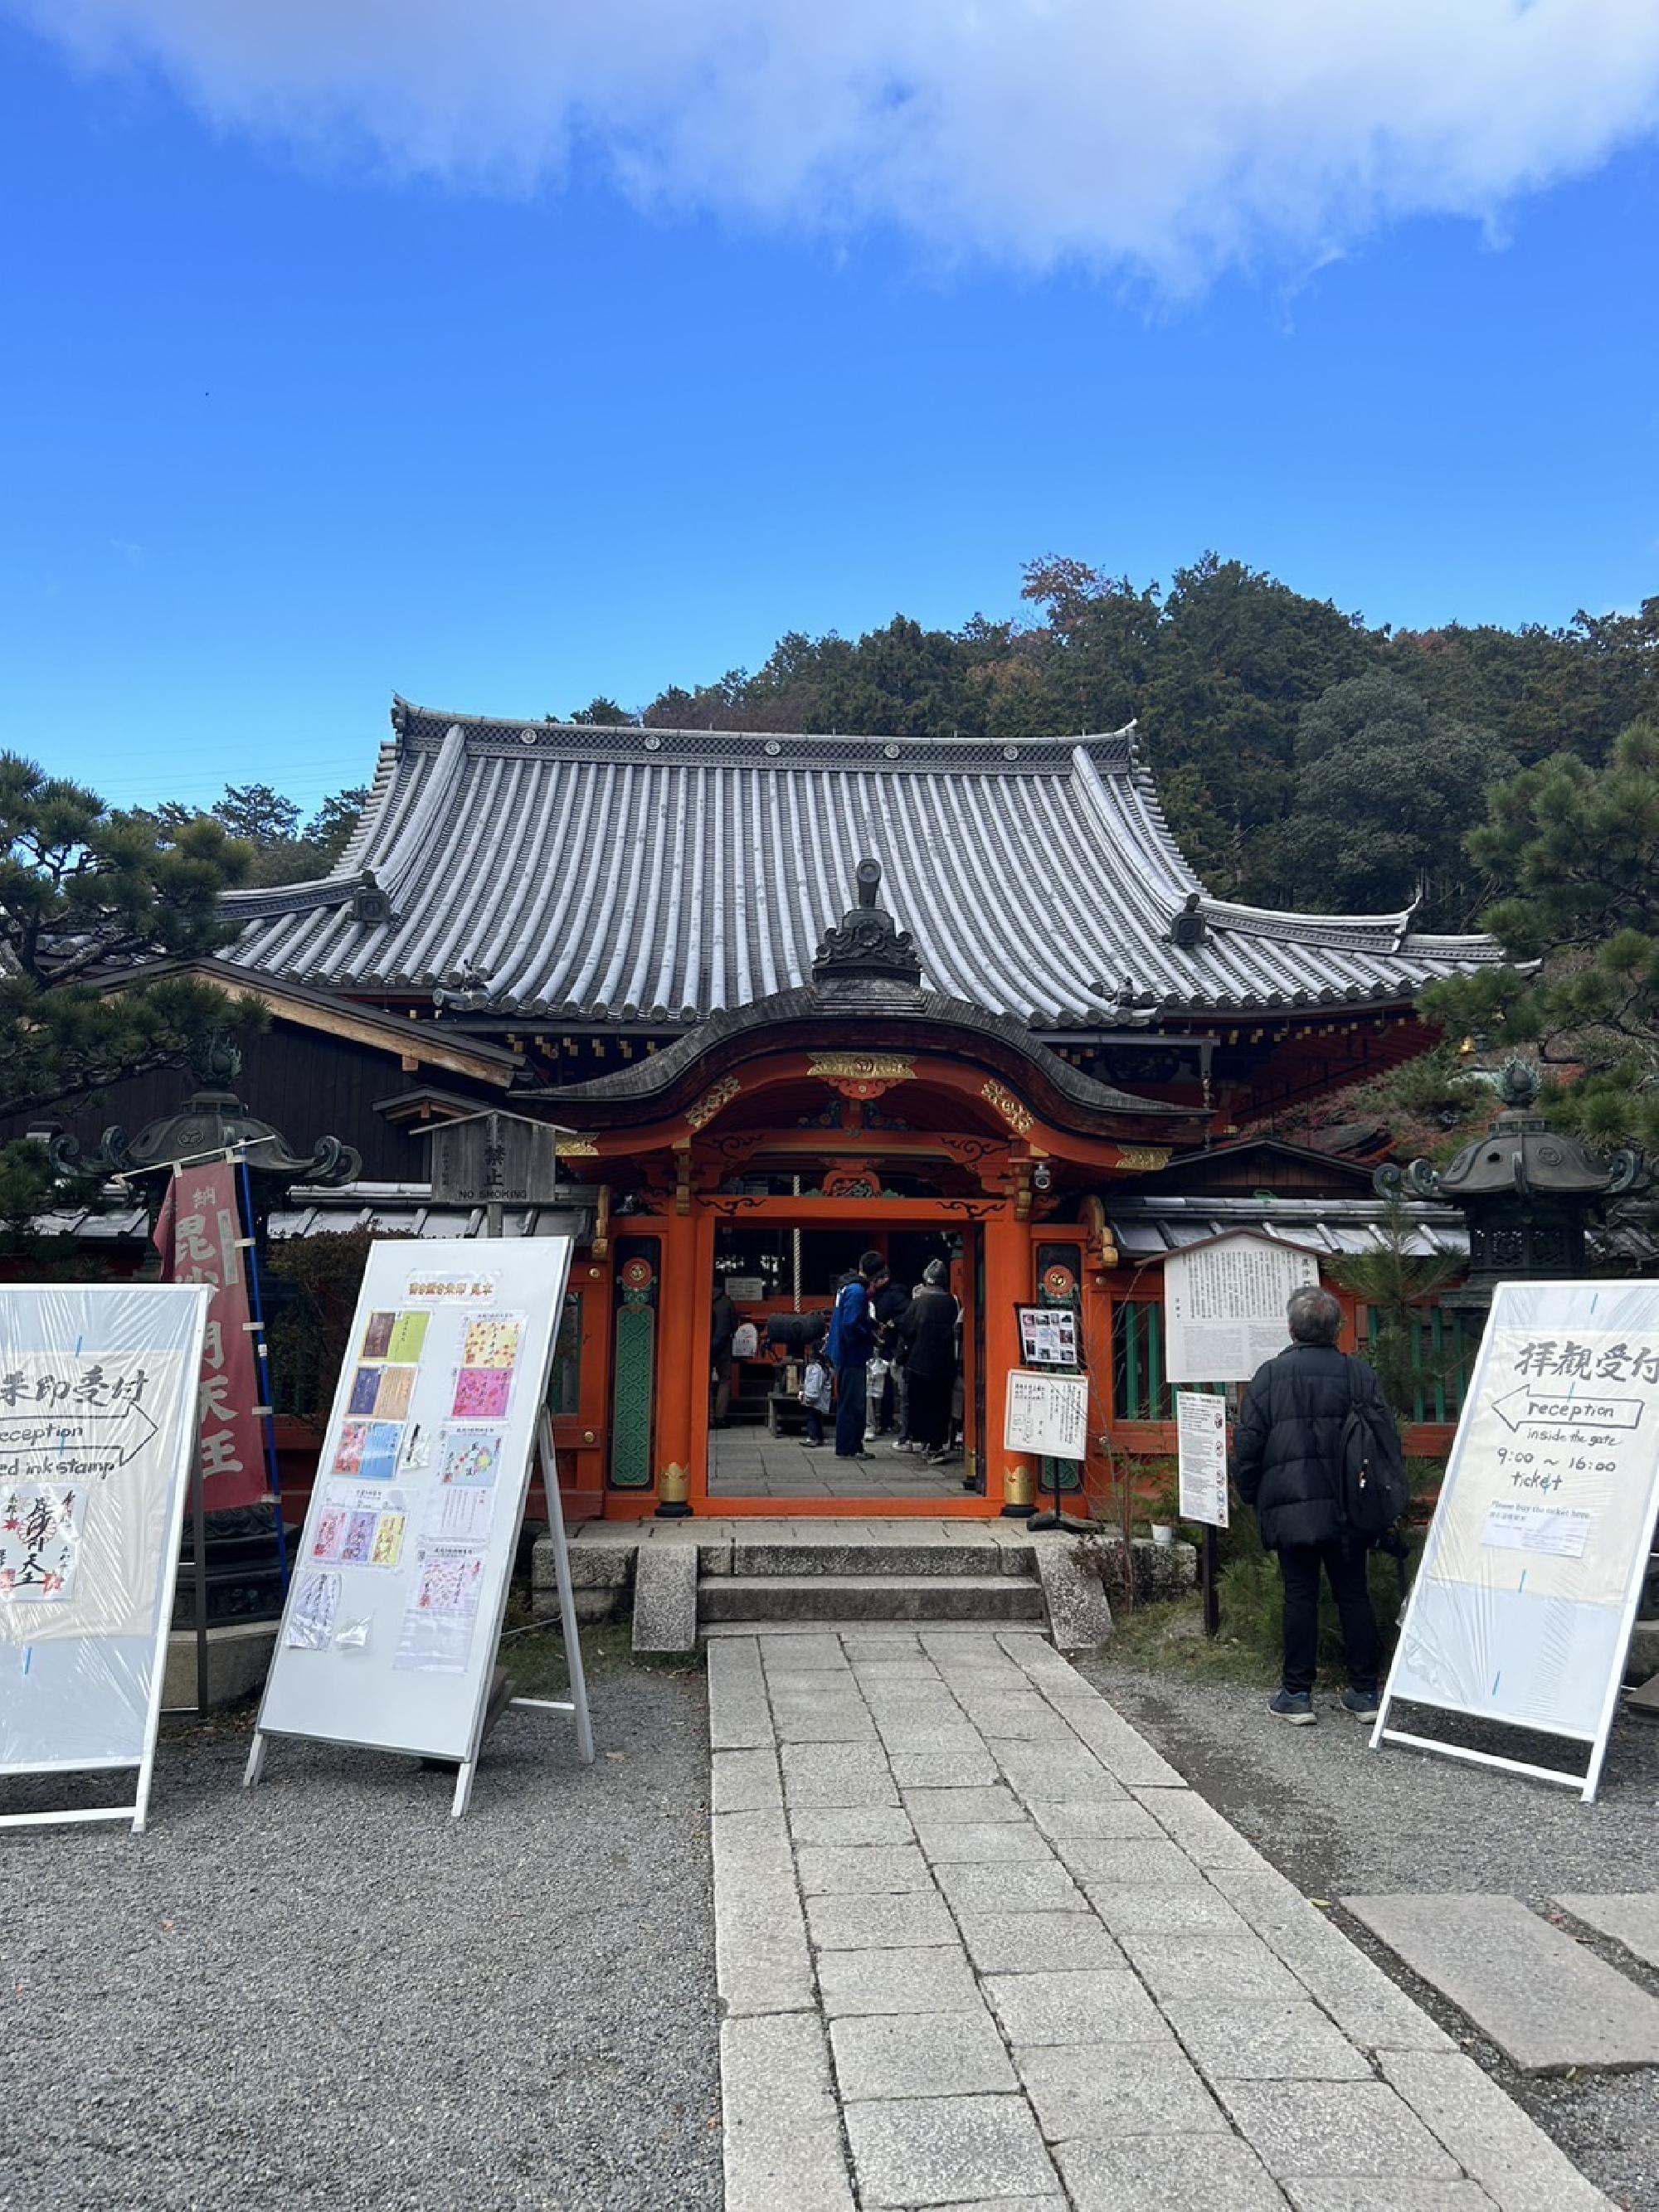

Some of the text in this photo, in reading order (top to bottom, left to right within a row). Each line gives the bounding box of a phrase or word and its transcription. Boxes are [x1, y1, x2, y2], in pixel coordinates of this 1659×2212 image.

[460, 1189, 527, 1200] NO SMOKING
[1514, 1340, 1659, 1384] 拝観受付
[1527, 1402, 1614, 1421] reception
[1527, 1428, 1623, 1446] inside the gate
[26, 1456, 53, 1474] ink
[56, 1458, 114, 1480] stamp
[1497, 1446, 1535, 1466] 9:00
[1569, 1456, 1616, 1472] 16:00
[1511, 1469, 1563, 1490] ticket
[1515, 1502, 1530, 1513] buy
[1532, 1505, 1545, 1514] the
